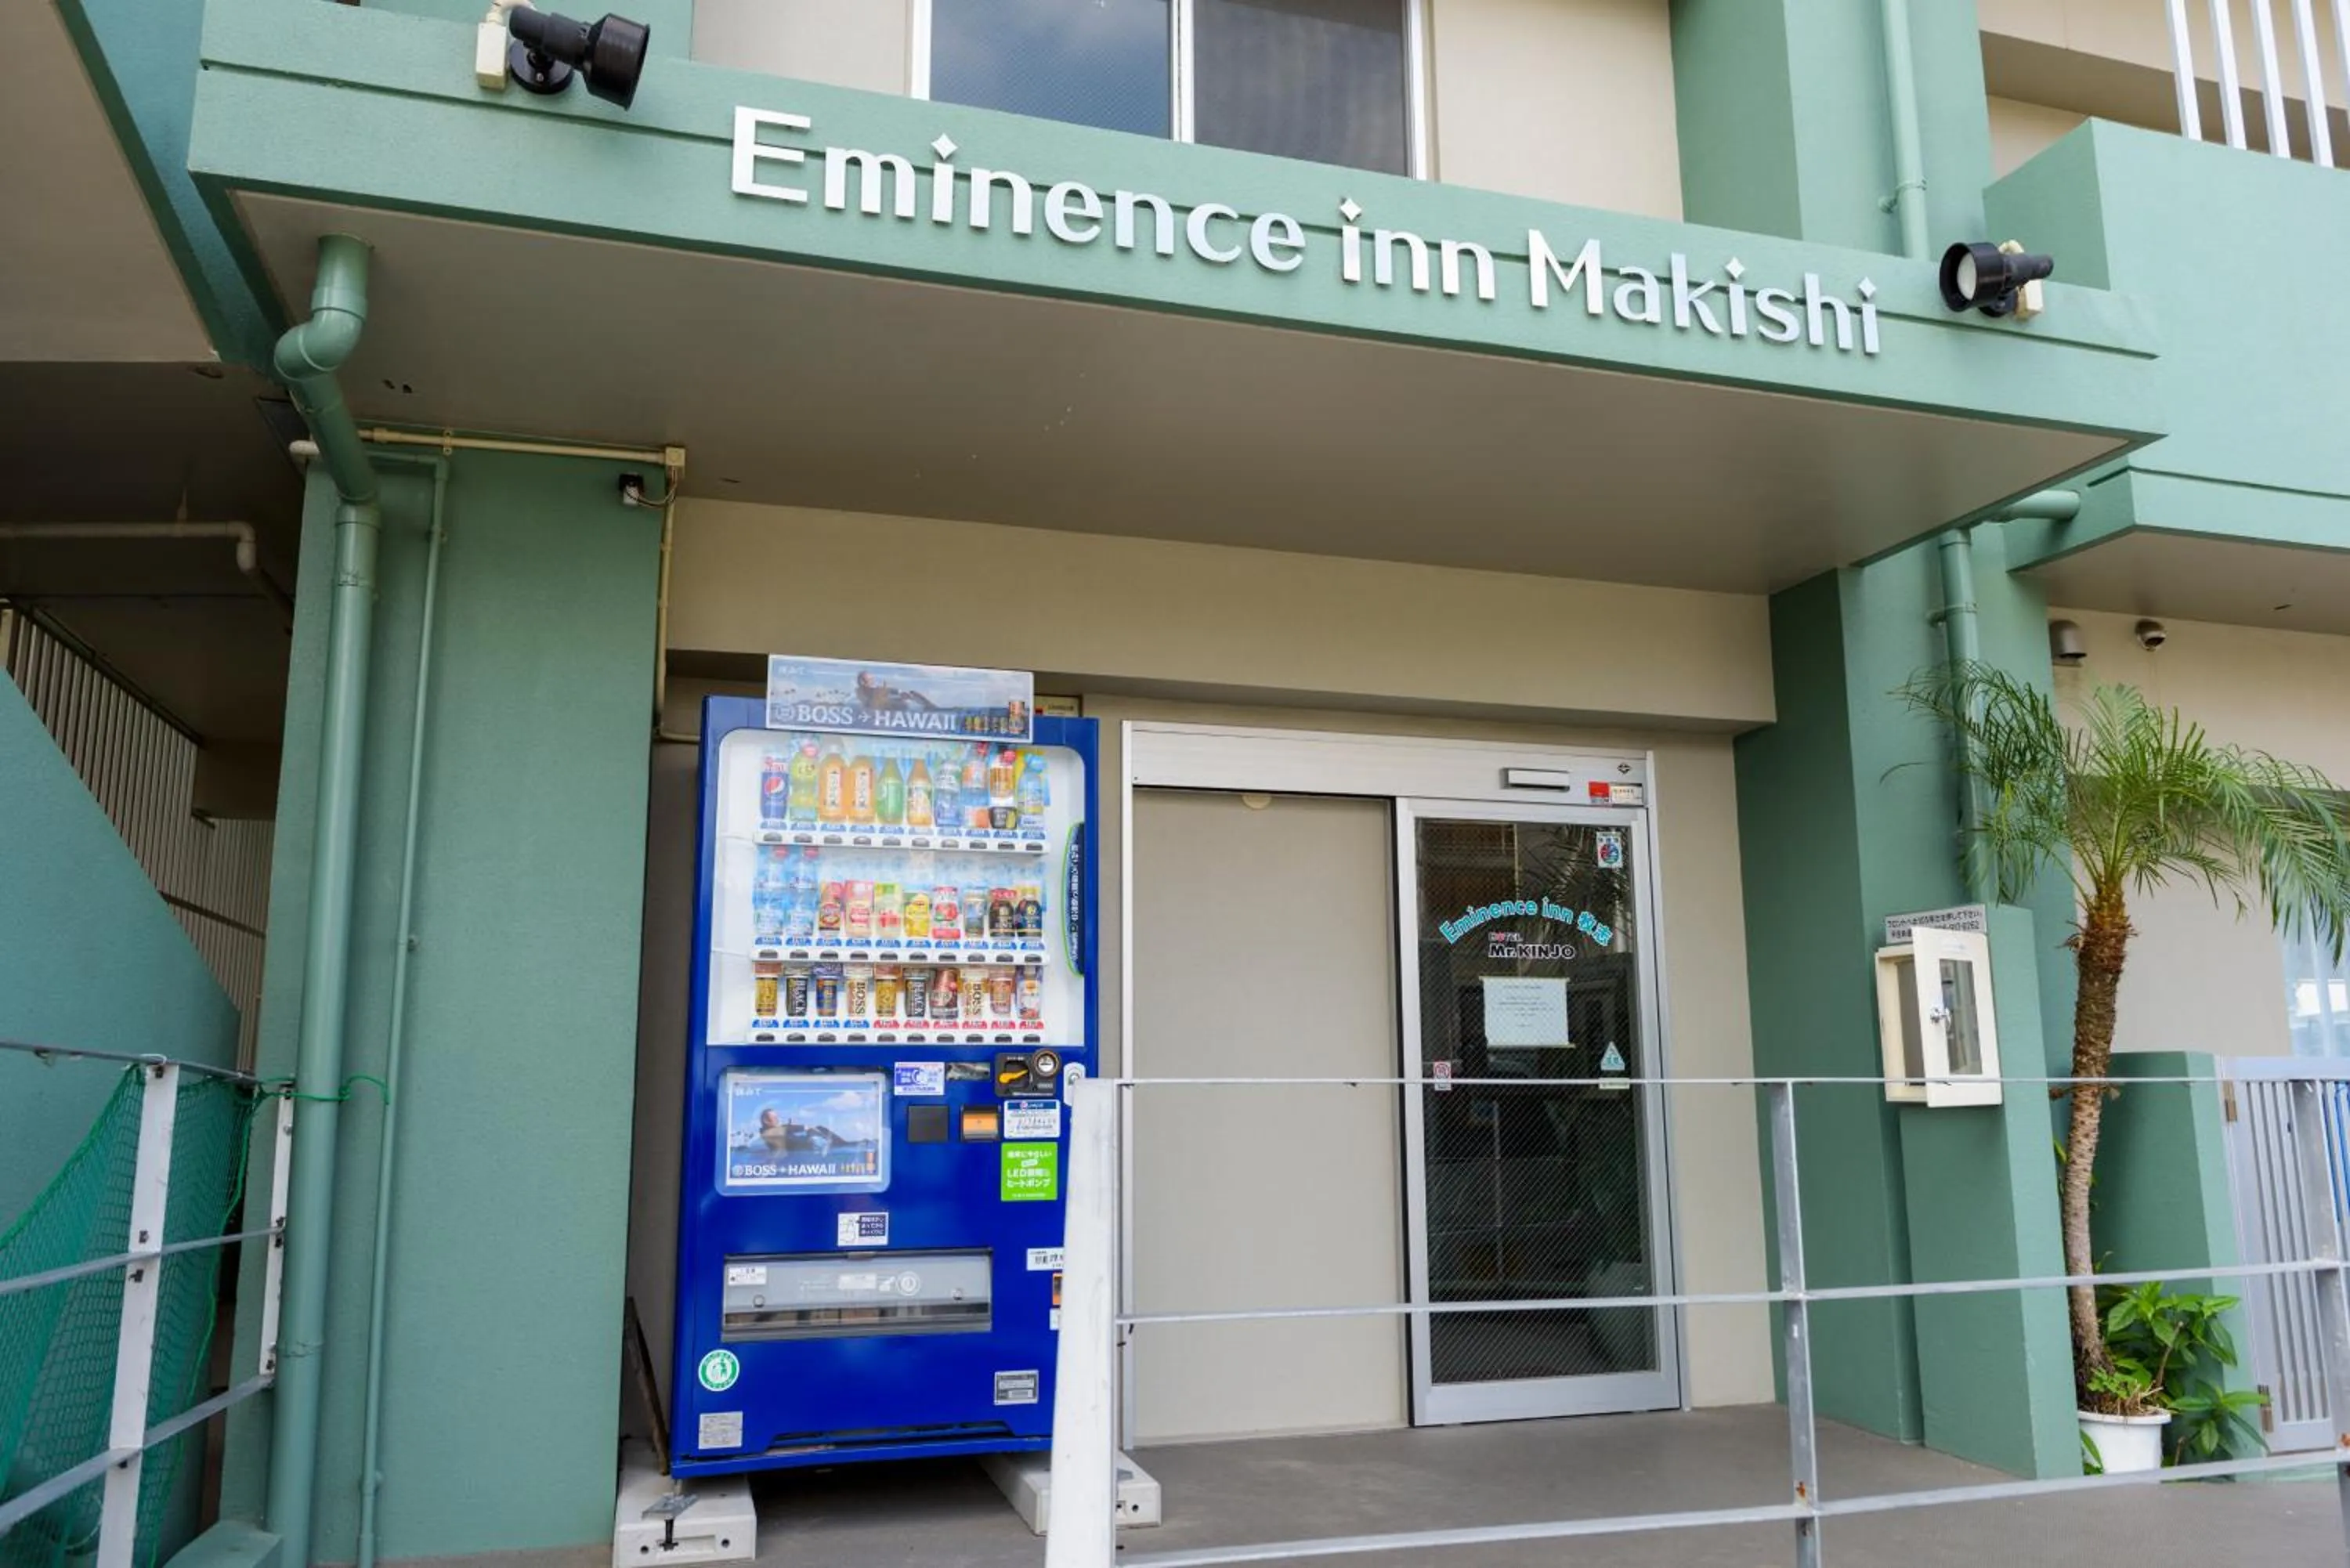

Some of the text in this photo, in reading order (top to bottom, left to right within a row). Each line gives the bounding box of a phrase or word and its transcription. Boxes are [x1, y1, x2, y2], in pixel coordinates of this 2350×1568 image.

[731, 105, 1878, 354] Eminence inn Makishi
[797, 705, 956, 731] BOSS HAWAII
[1439, 900, 1538, 945] Eminence
[1542, 896, 1574, 924] inn
[855, 981, 866, 1014] BOSS
[744, 1163, 836, 1176] BOSS HAWAII
